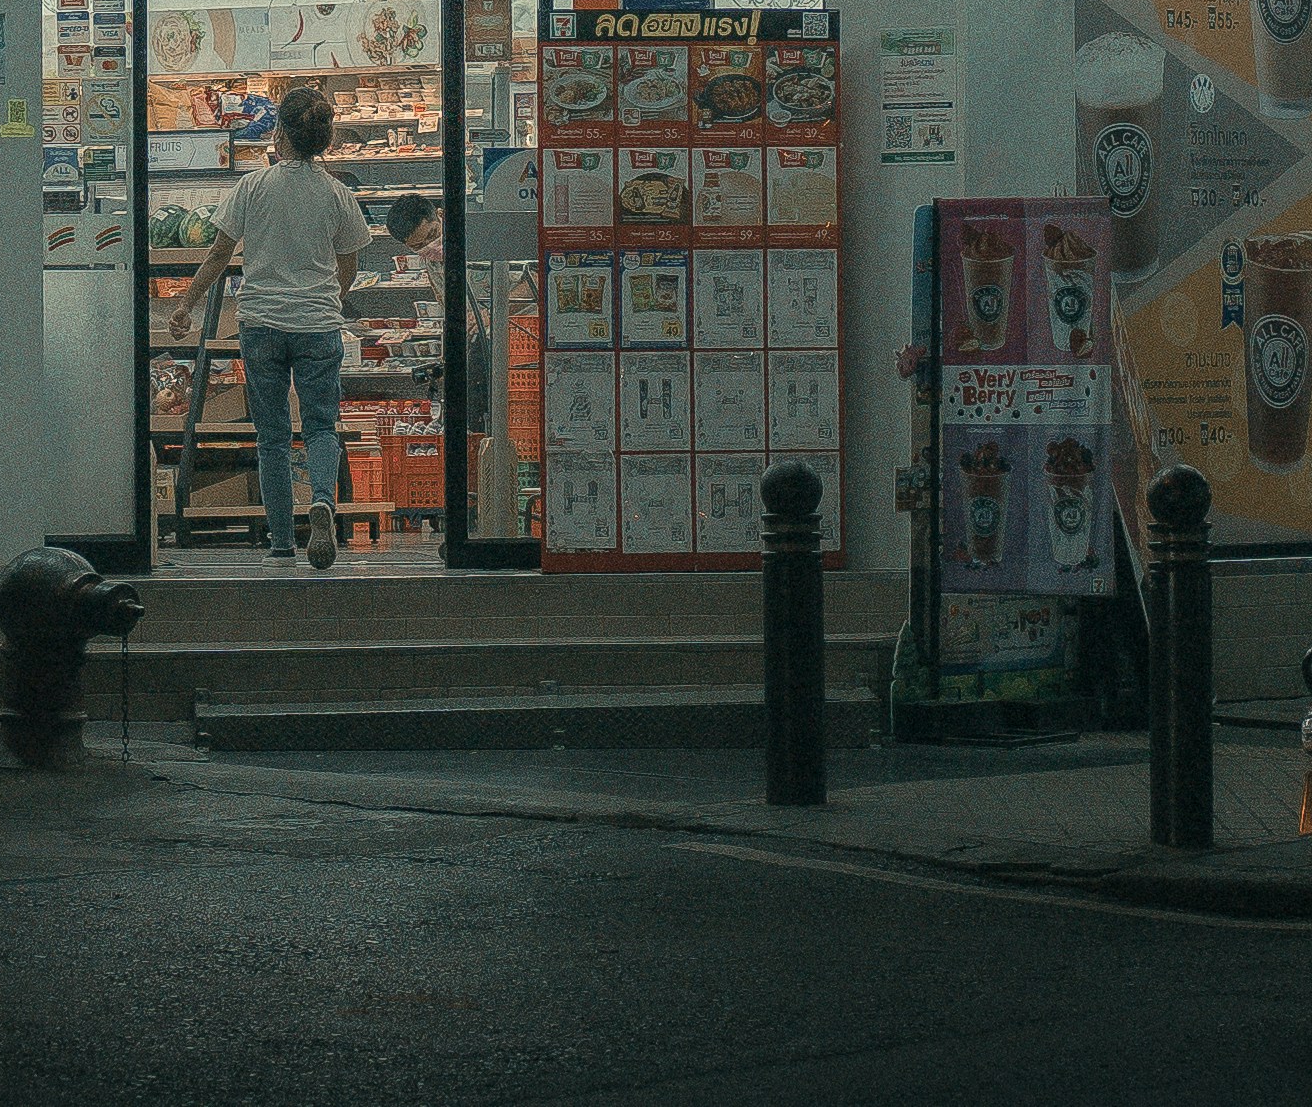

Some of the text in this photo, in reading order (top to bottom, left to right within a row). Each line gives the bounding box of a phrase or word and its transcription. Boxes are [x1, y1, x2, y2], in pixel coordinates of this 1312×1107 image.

[149, 141, 183, 153] FRUITS
[973, 368, 1017, 388] Very
[963, 386, 1017, 408] Berry
